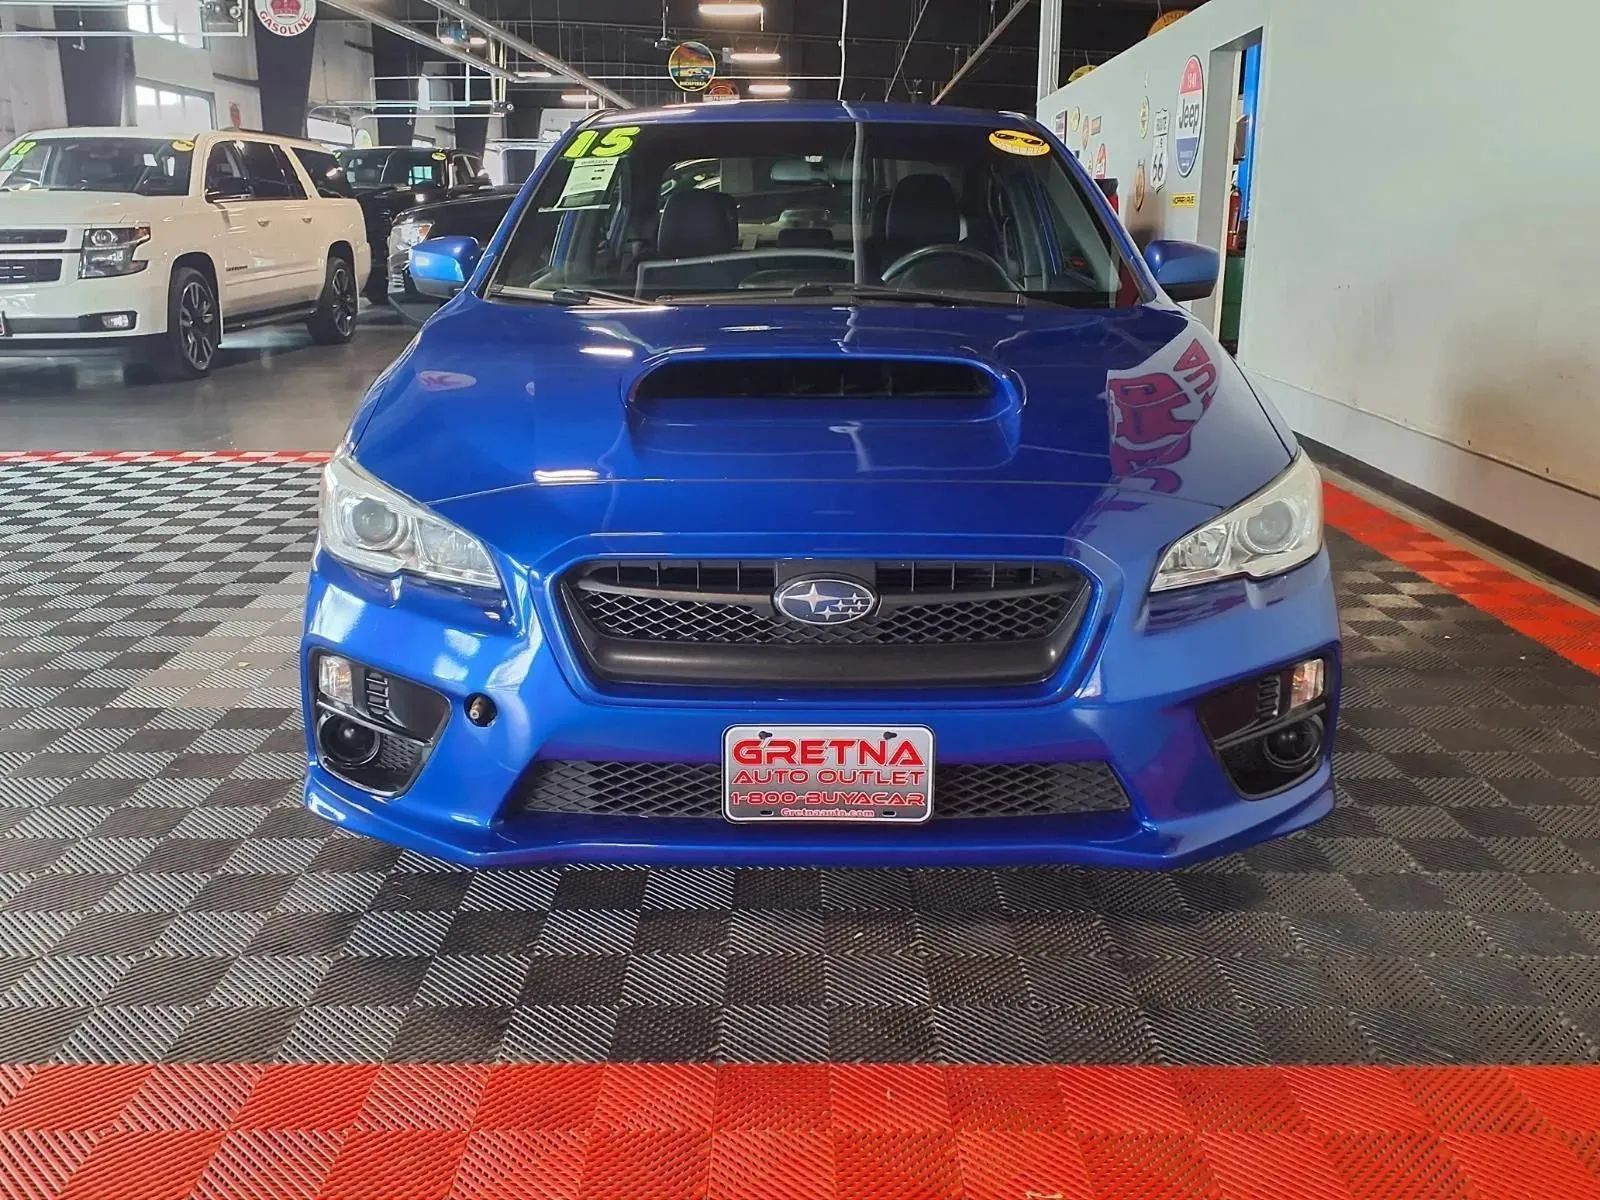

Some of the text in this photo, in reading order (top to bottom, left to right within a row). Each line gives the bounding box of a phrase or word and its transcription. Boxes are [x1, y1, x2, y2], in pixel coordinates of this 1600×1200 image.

[260, 10, 312, 35] GASOLINE
[1178, 98, 1199, 134] Jeep
[563, 126, 641, 158] 15
[1152, 152, 1164, 182] 66
[732, 739, 925, 766] GRETNA
[731, 769, 925, 786] AUTO OUTLET
[731, 791, 926, 806] 1-800-BUYACAR
[780, 808, 875, 817] Gretnaauto.com
